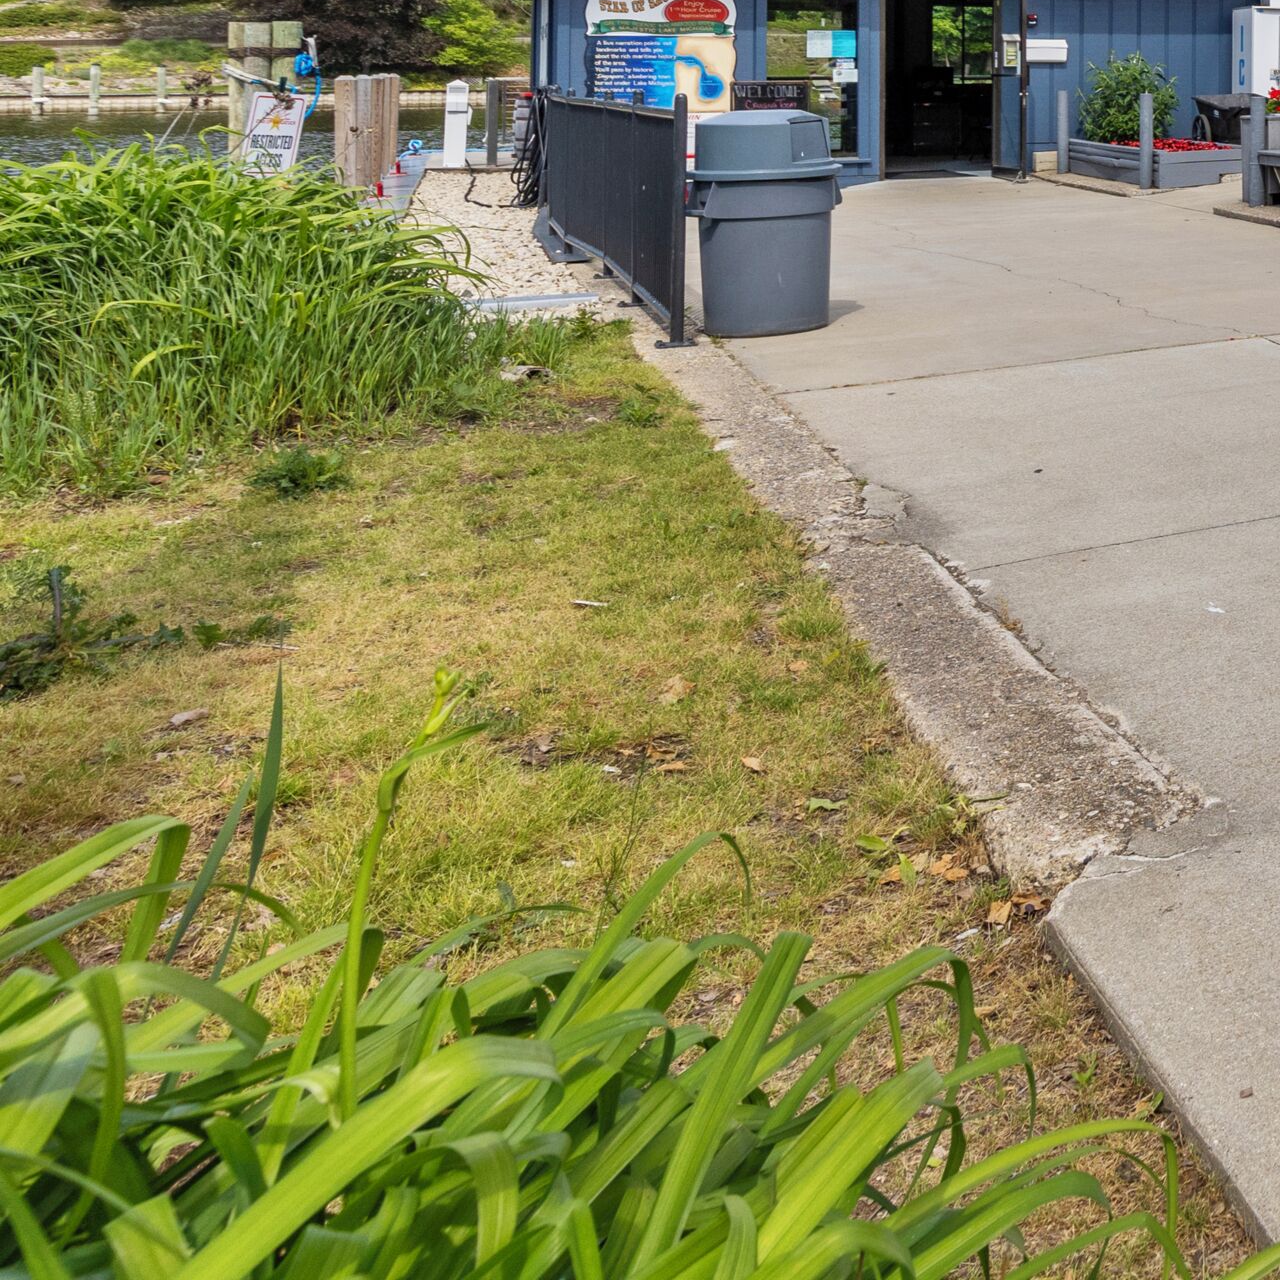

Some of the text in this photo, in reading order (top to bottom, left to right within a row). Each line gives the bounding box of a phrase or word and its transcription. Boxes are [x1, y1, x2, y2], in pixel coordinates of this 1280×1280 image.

[599, 0, 629, 13] STAR
[631, 0, 645, 12] OF
[734, 85, 804, 98] WELCOME
[250, 134, 293, 150] RESTRICTED
